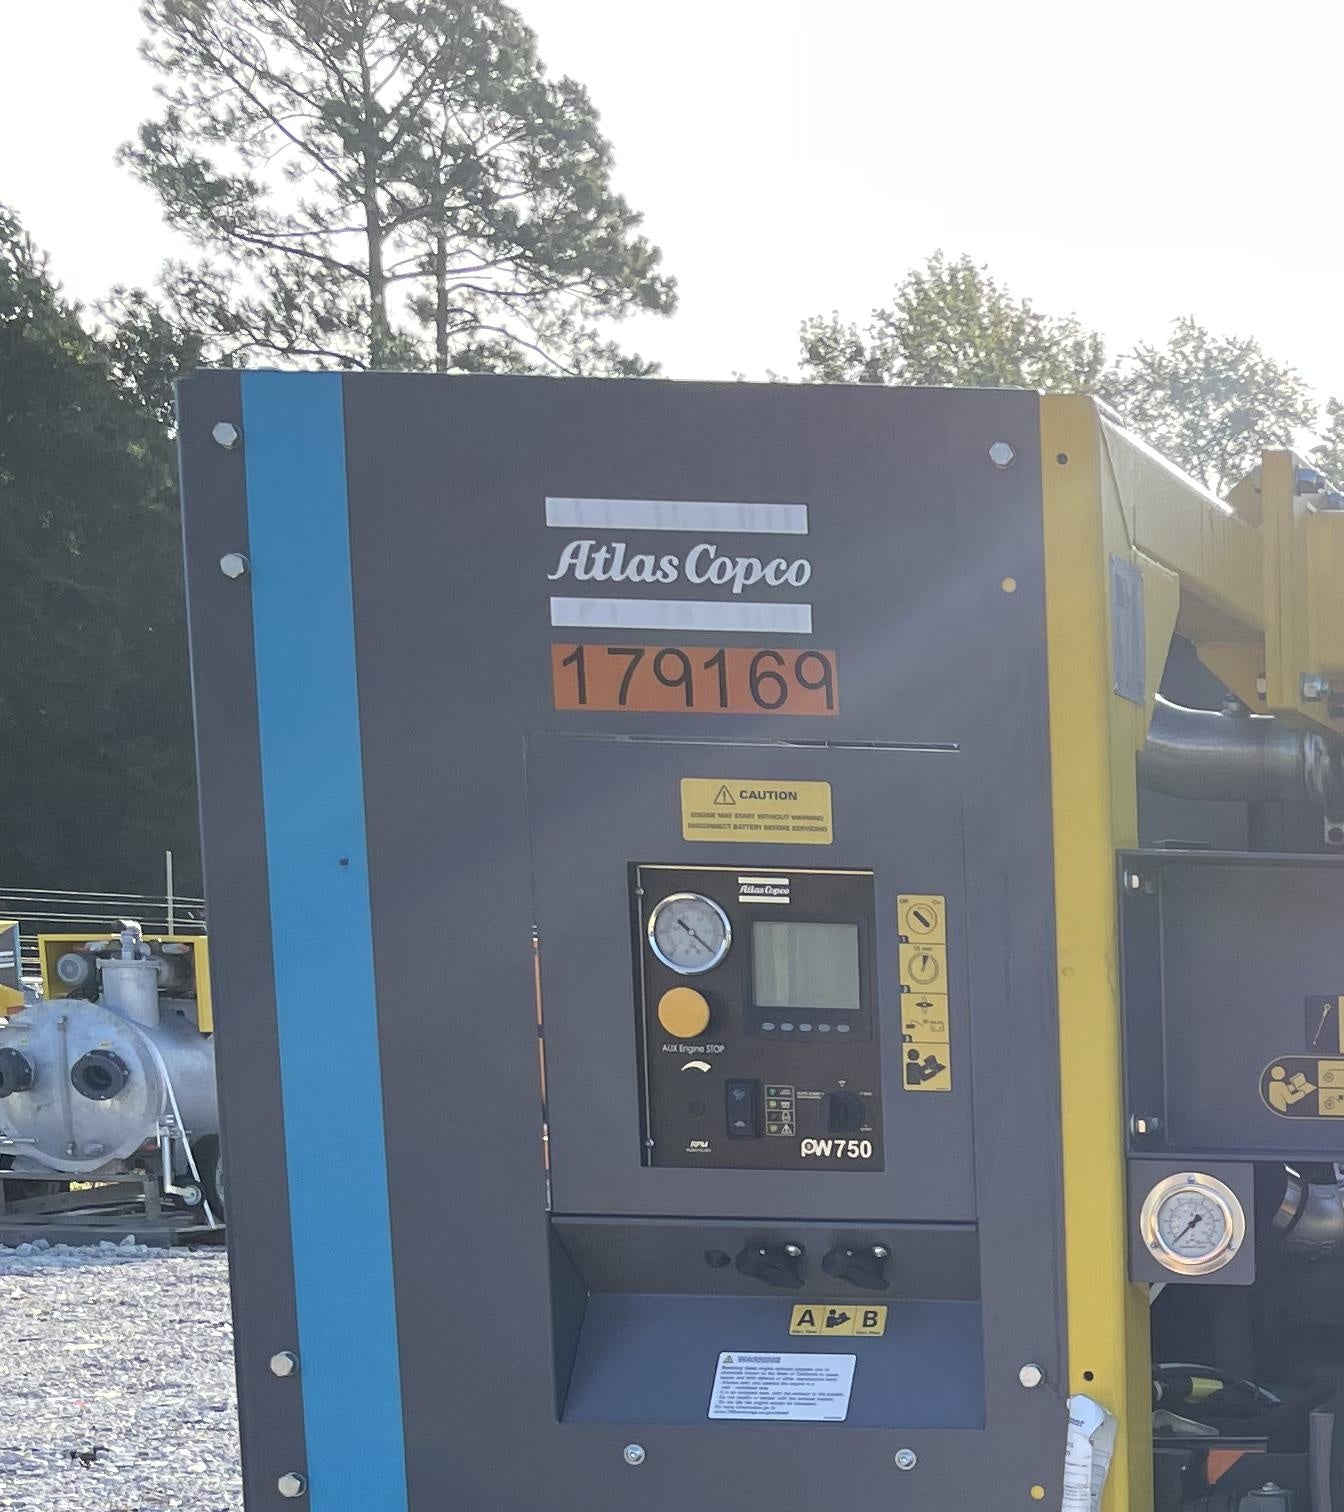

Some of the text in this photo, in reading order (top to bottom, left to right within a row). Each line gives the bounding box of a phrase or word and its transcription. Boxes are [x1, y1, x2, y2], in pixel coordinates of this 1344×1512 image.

[547, 540, 812, 594] Atlas Copco
[562, 645, 835, 710] 179169
[739, 790, 798, 801] CAUTION
[662, 1044, 725, 1054] AUX Engine STOP
[797, 1309, 878, 1328] A B
